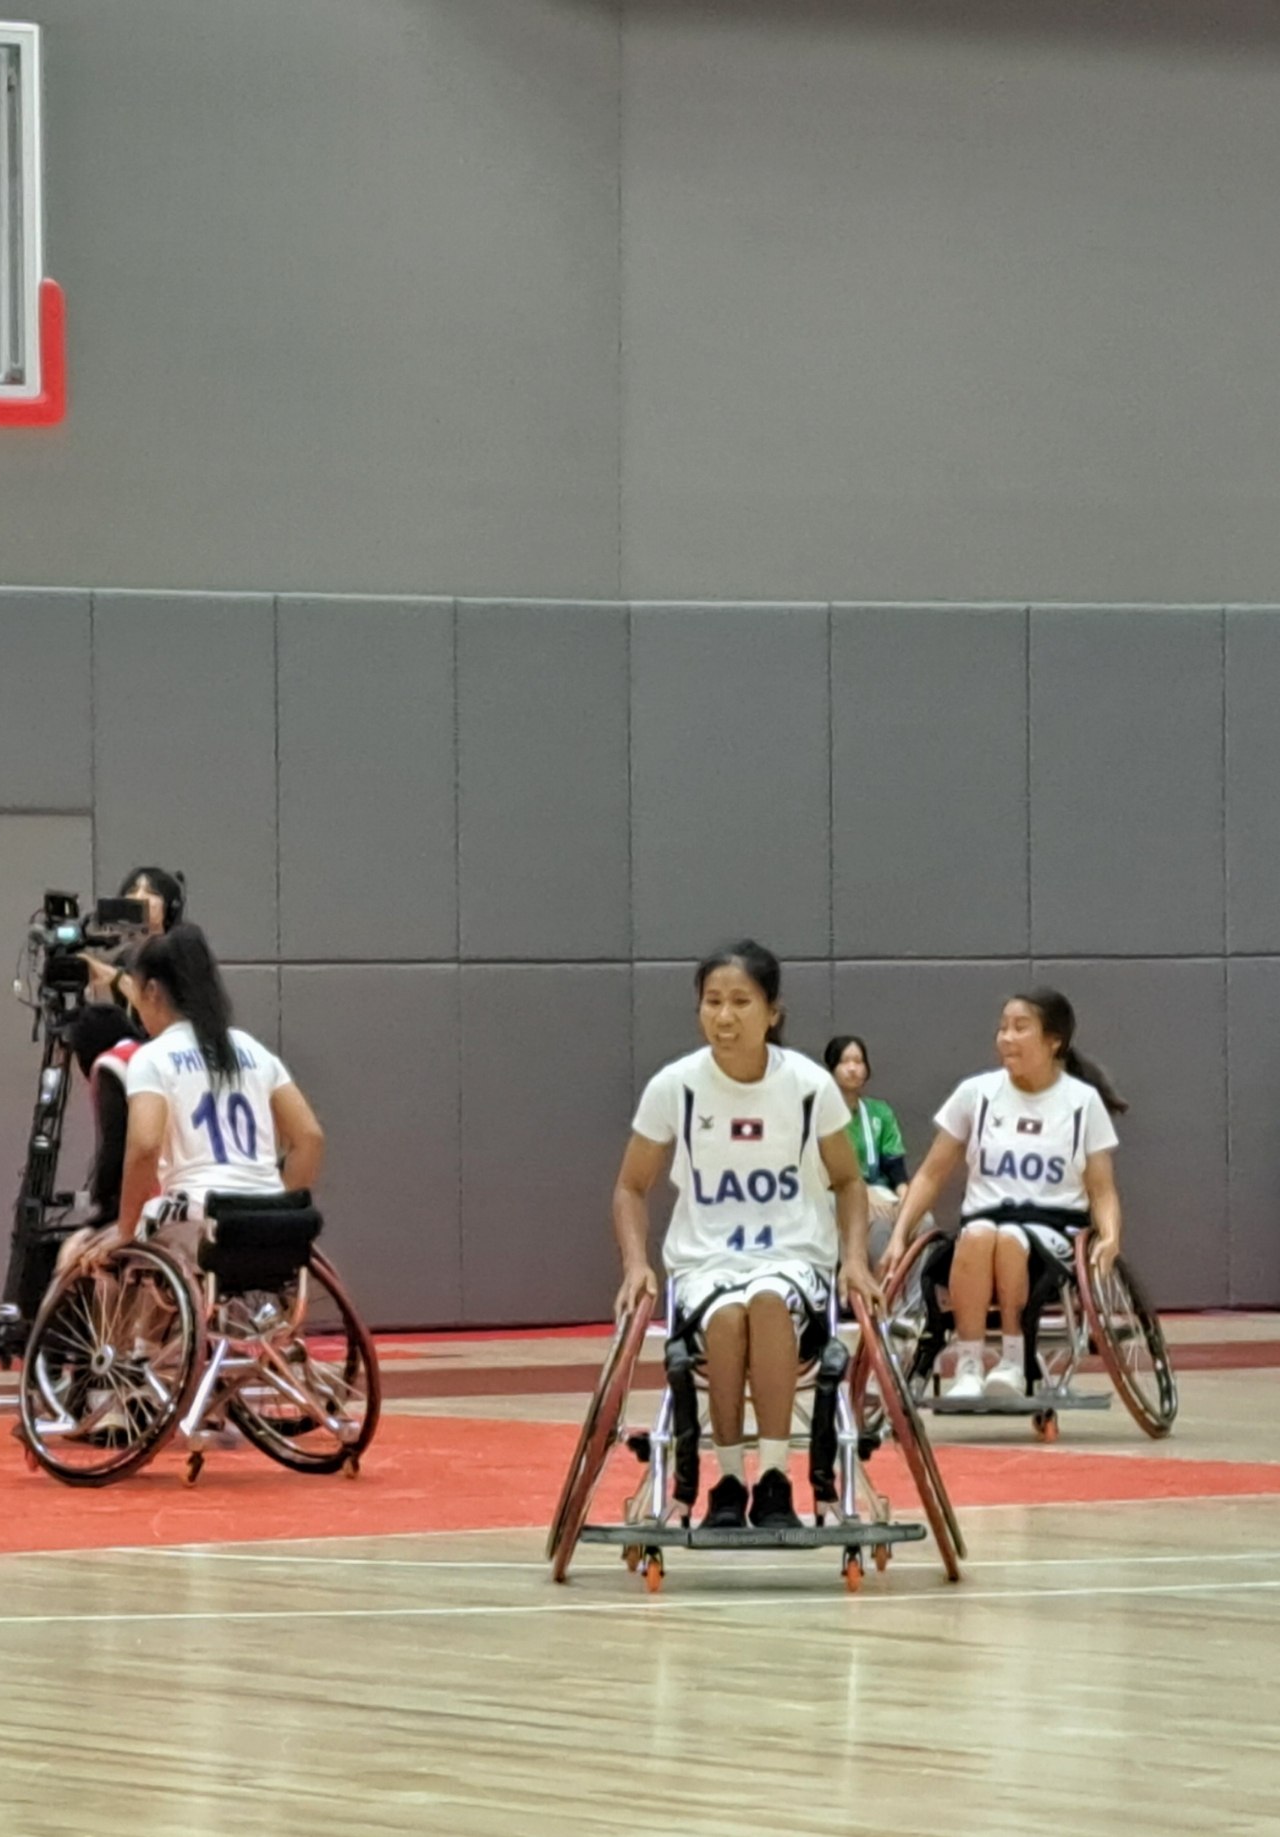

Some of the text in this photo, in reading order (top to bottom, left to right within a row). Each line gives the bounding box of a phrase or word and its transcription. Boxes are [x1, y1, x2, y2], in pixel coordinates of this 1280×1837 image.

[191, 1091, 257, 1164] 10
[692, 1165, 800, 1206] LAOS
[978, 1148, 1066, 1185] LAOS
